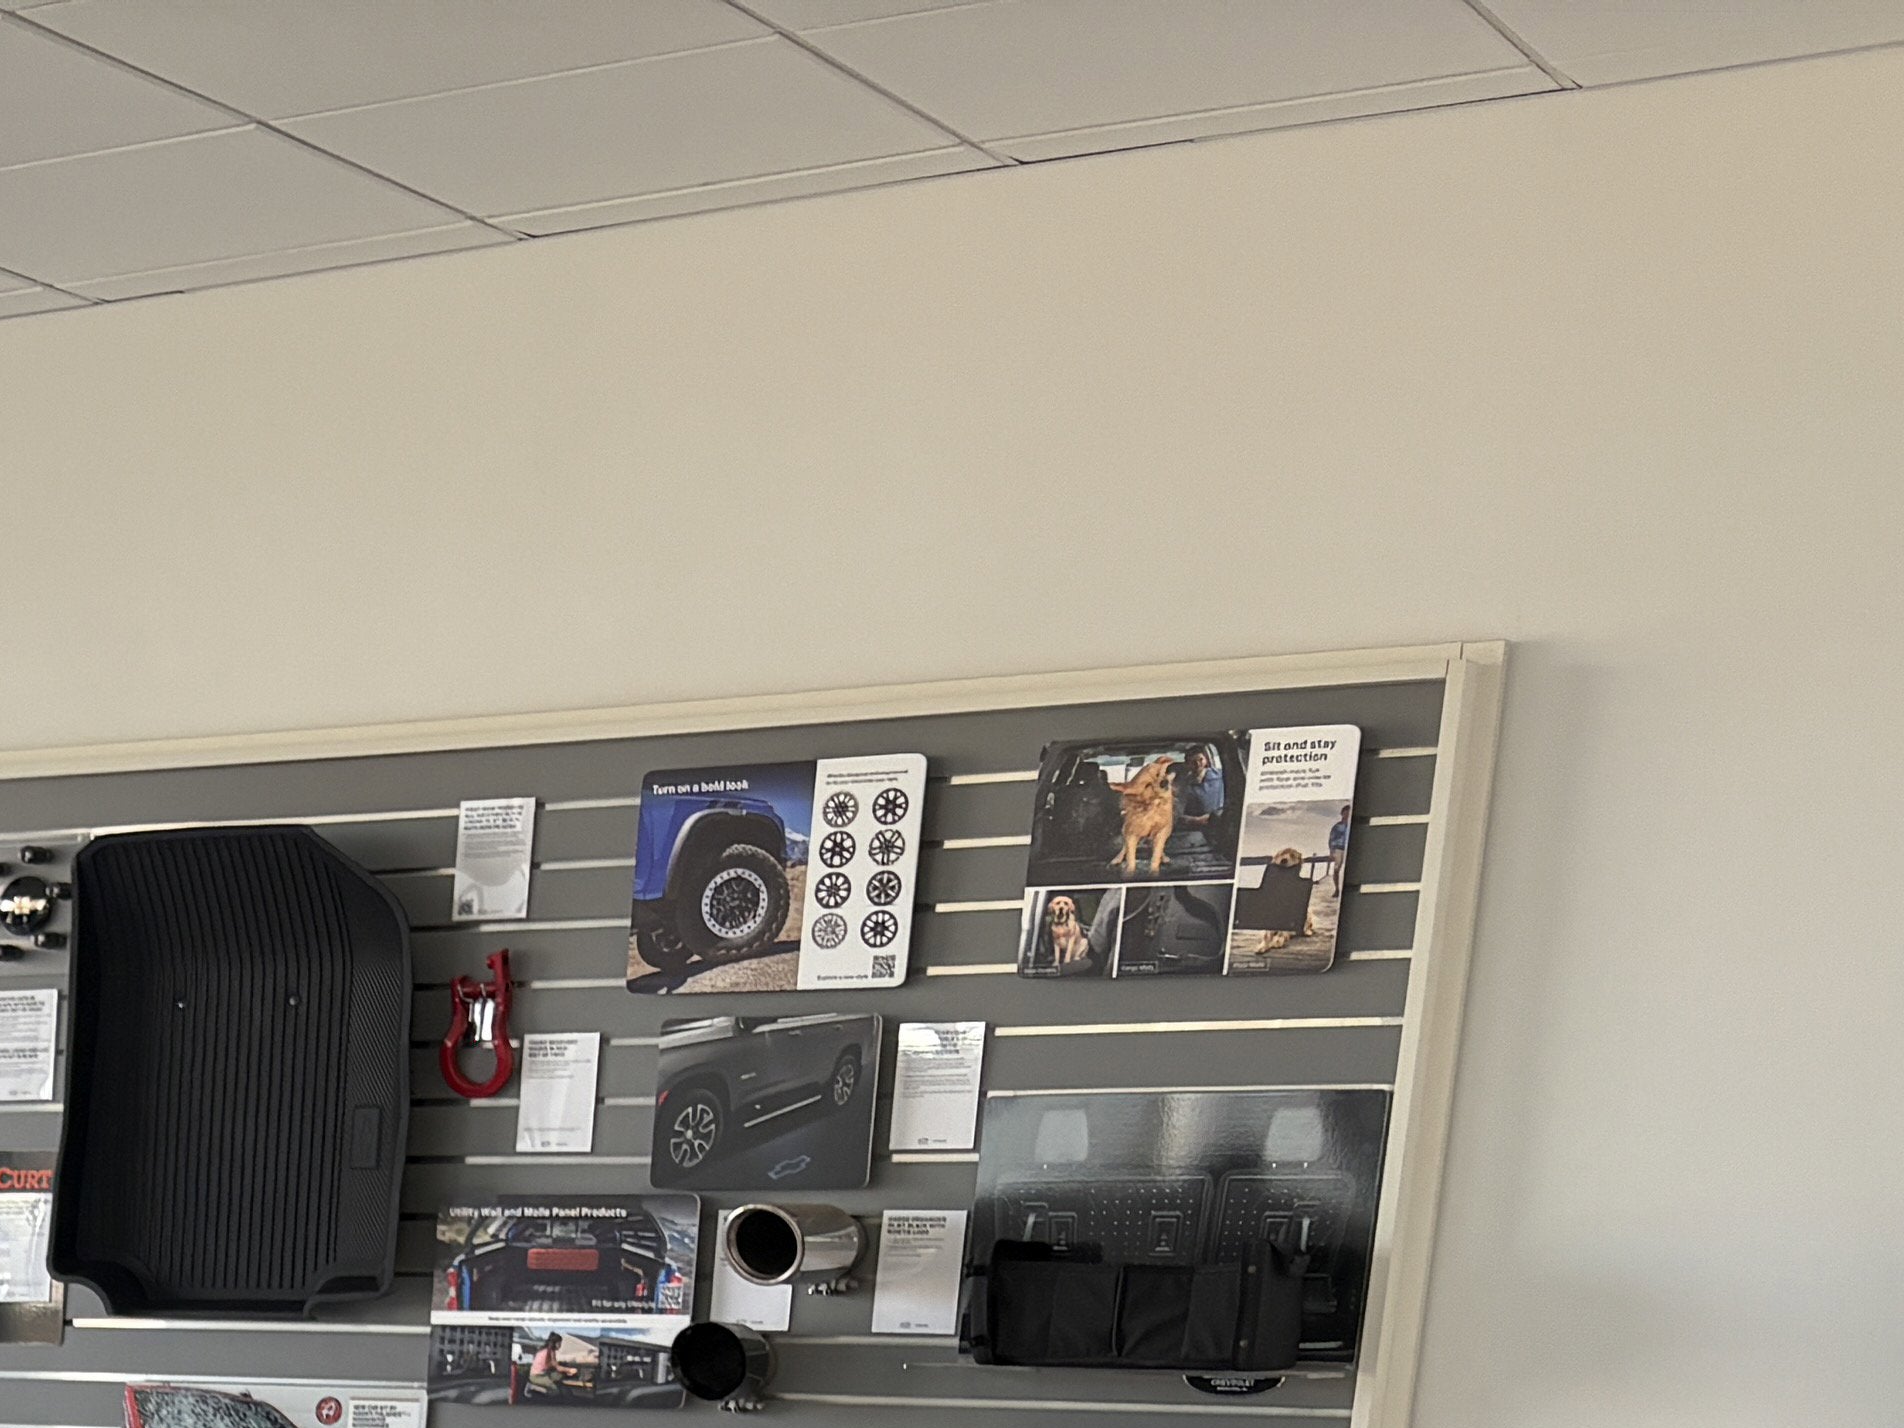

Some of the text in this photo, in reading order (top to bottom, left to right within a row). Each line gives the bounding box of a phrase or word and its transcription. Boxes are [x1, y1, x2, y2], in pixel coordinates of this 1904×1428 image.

[1264, 739, 1337, 752] Sit and stay
[1262, 752, 1328, 766] protection
[653, 784, 676, 795] Turn
[677, 784, 691, 794] on
[692, 783, 699, 793] a
[701, 780, 724, 792] bold
[449, 1207, 479, 1219] Utility
[480, 1206, 503, 1217] Wall
[504, 1207, 522, 1217] and
[552, 1206, 580, 1218] Panel
[581, 1206, 628, 1218] Products
